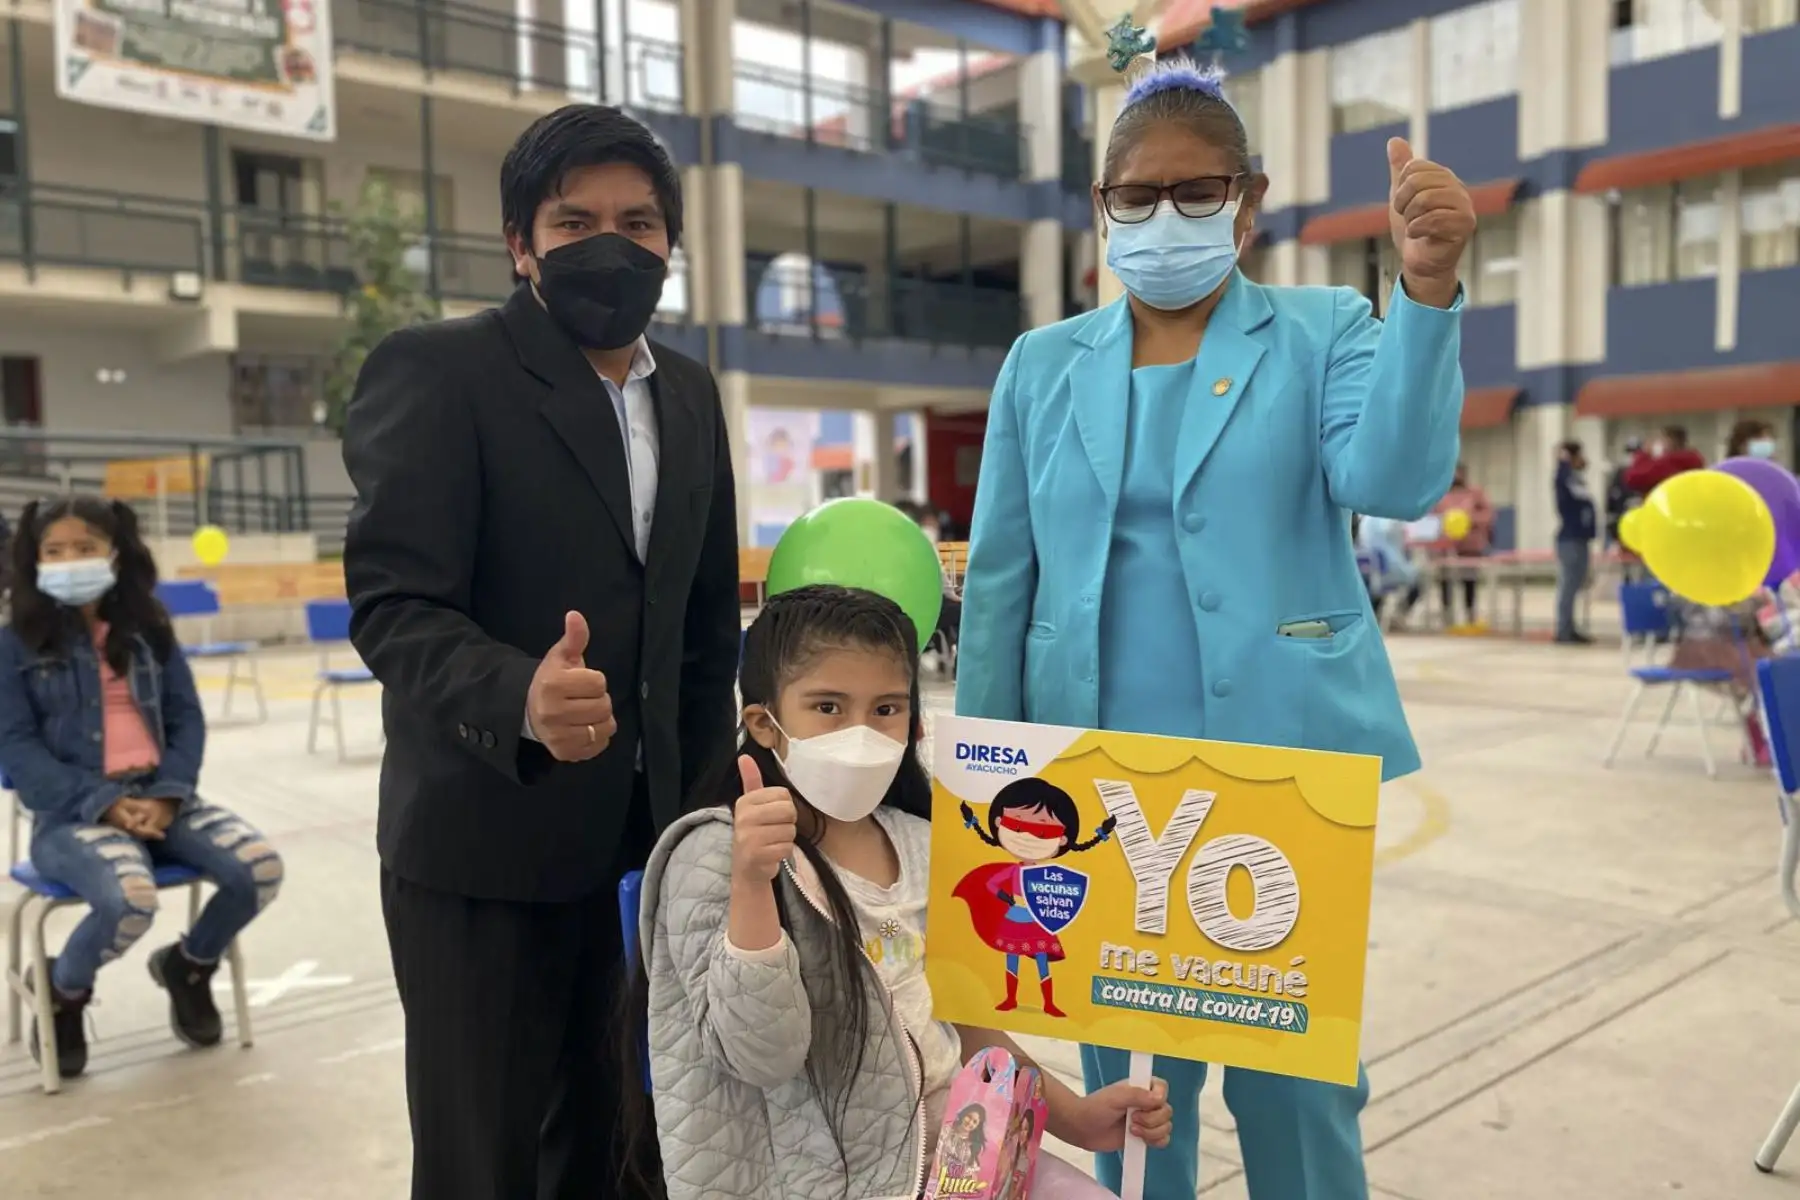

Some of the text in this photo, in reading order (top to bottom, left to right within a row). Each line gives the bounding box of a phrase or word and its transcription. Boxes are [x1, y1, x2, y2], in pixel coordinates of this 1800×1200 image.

[956, 743, 1029, 766] DIRESA
[966, 763, 1018, 776] AYACUCHO
[1092, 777, 1300, 951] Yo
[1043, 868, 1064, 882] Las
[1031, 882, 1080, 896] vacunas
[1035, 894, 1074, 908] salvan
[1039, 906, 1071, 920] vidas
[1100, 941, 1308, 997] me vacuné
[1101, 983, 1295, 1026] contra la covid-19
